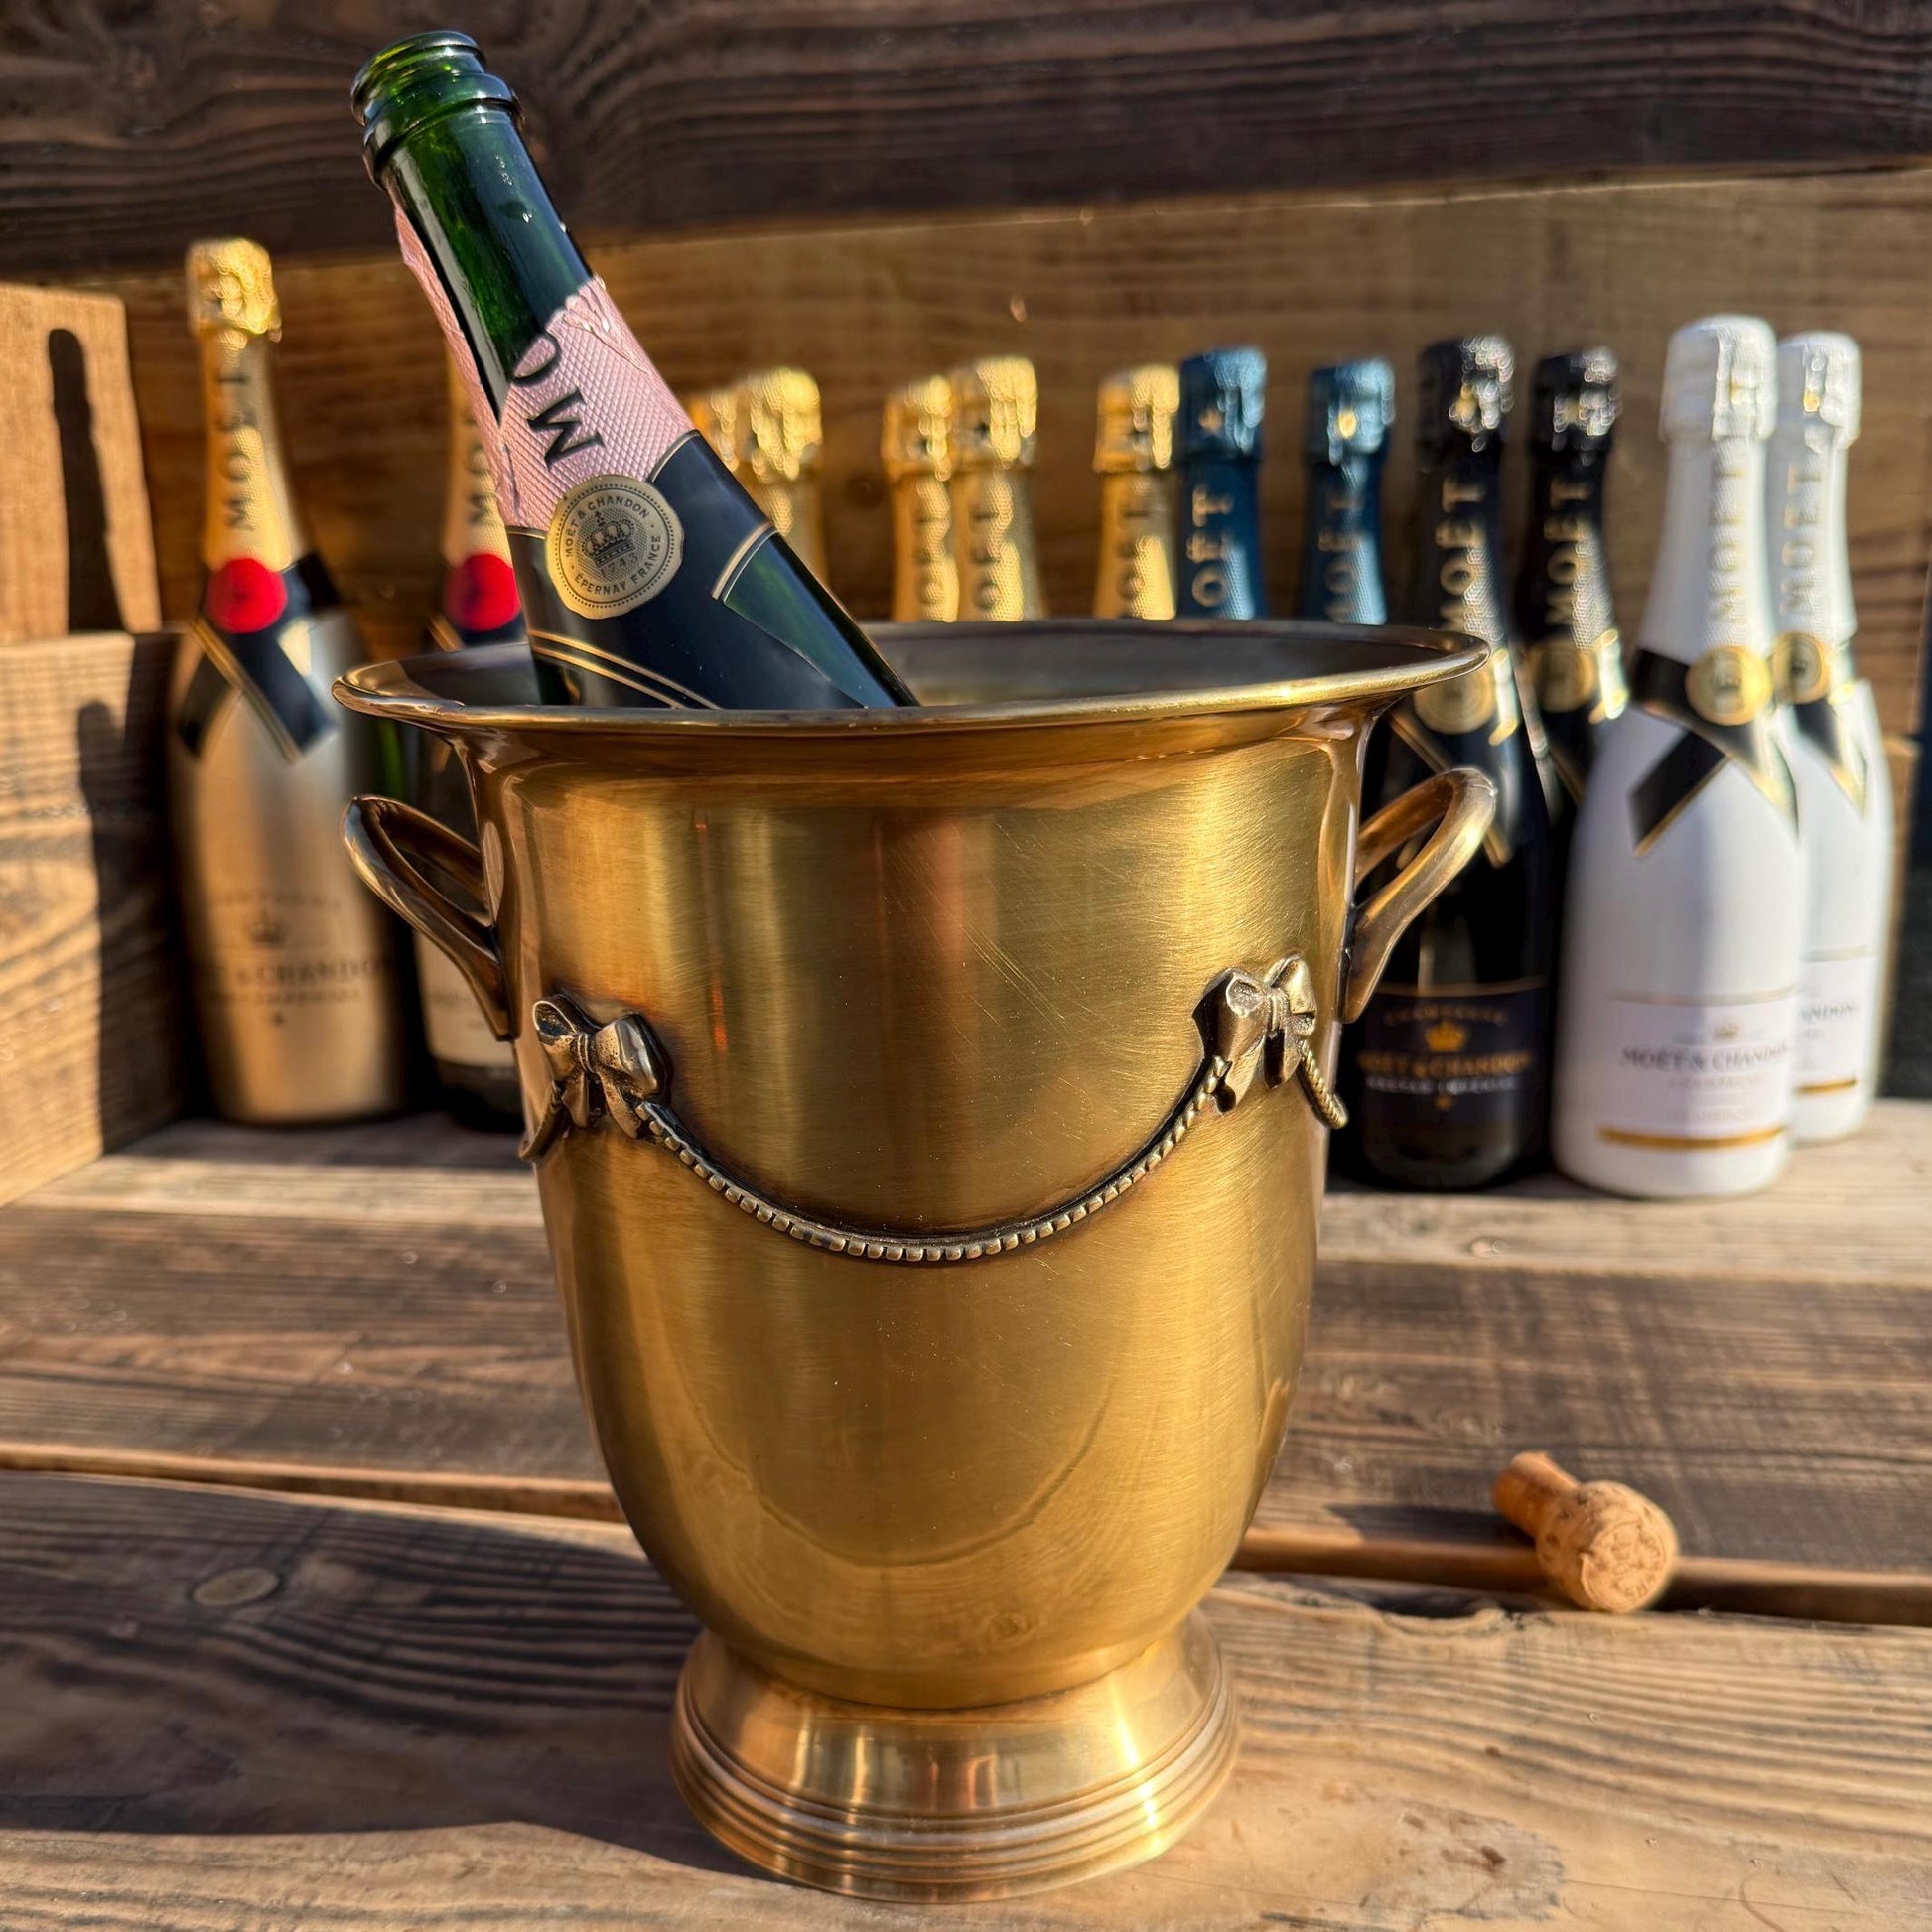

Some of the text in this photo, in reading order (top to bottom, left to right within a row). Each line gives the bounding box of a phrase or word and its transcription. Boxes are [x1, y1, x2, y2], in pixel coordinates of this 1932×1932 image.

[577, 510, 587, 519] &
[588, 495, 650, 518] CHANDON
[631, 535, 661, 585] FRANCE
